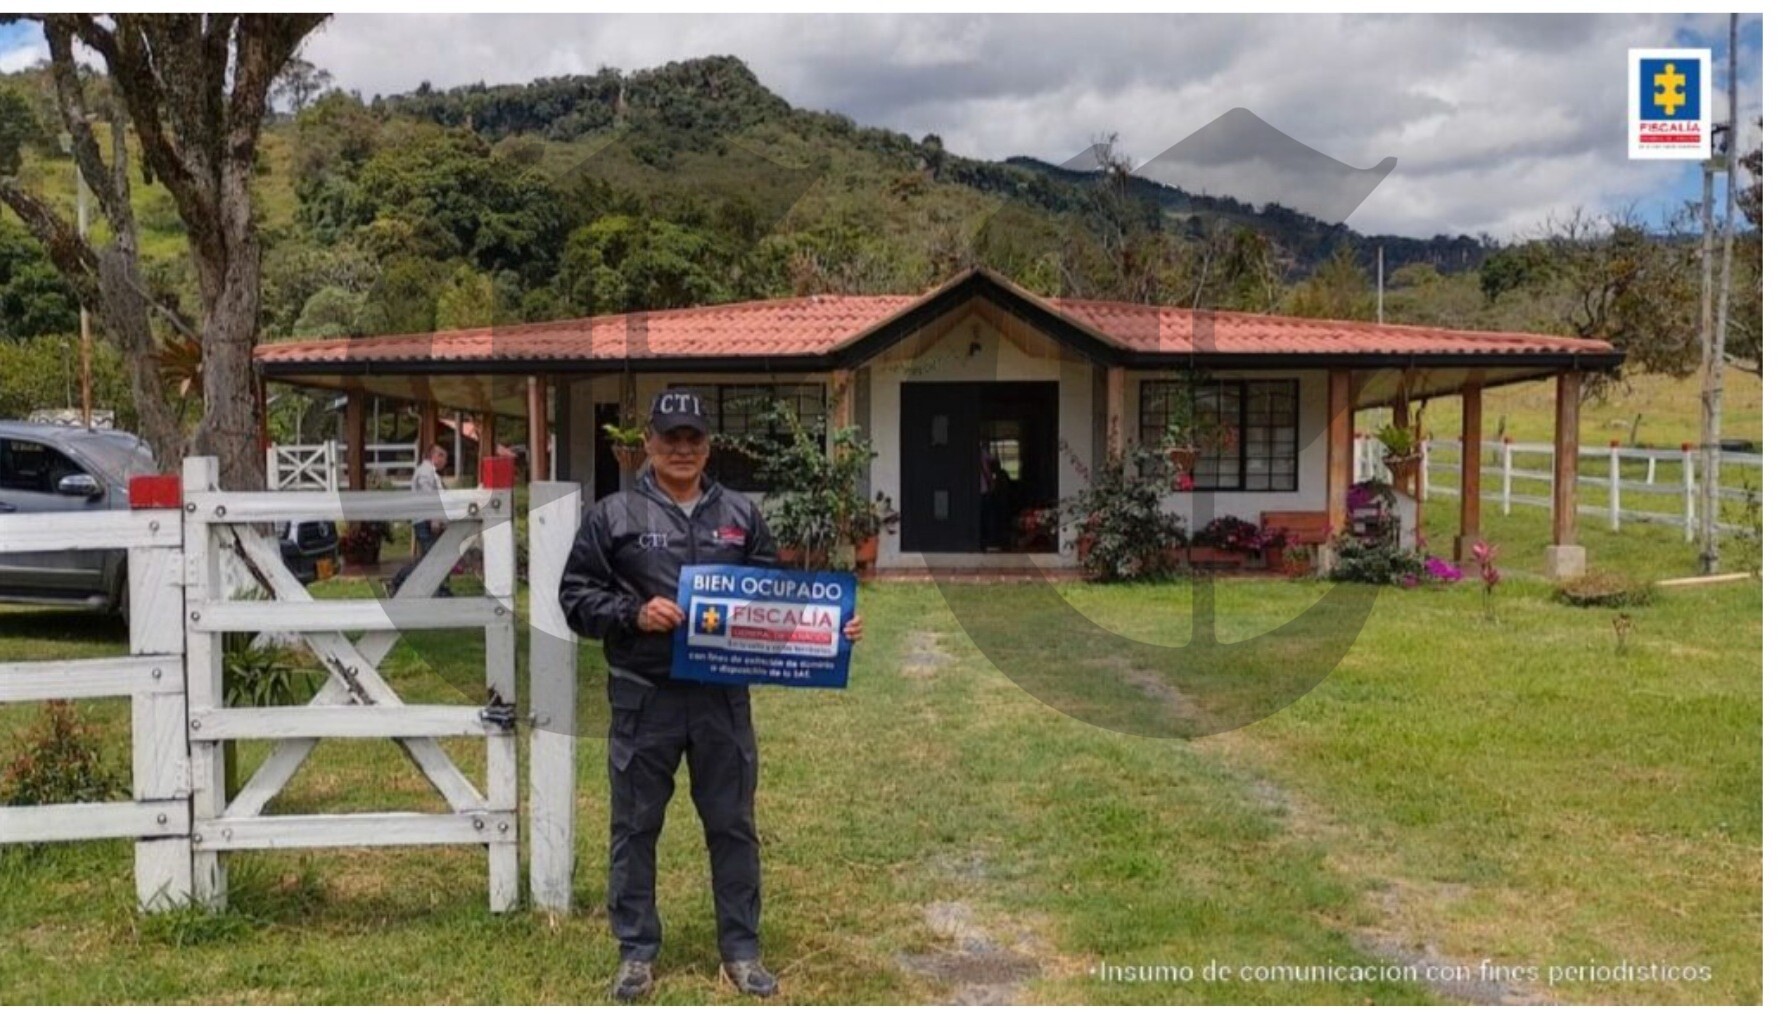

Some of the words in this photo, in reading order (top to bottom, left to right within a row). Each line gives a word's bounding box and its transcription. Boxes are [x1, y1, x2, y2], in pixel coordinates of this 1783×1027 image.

[660, 393, 700, 416] CTI
[638, 533, 668, 549] CTI
[693, 574, 735, 592] BIEN
[741, 577, 842, 600] OCUPADO
[732, 604, 833, 628] FISCALÍA
